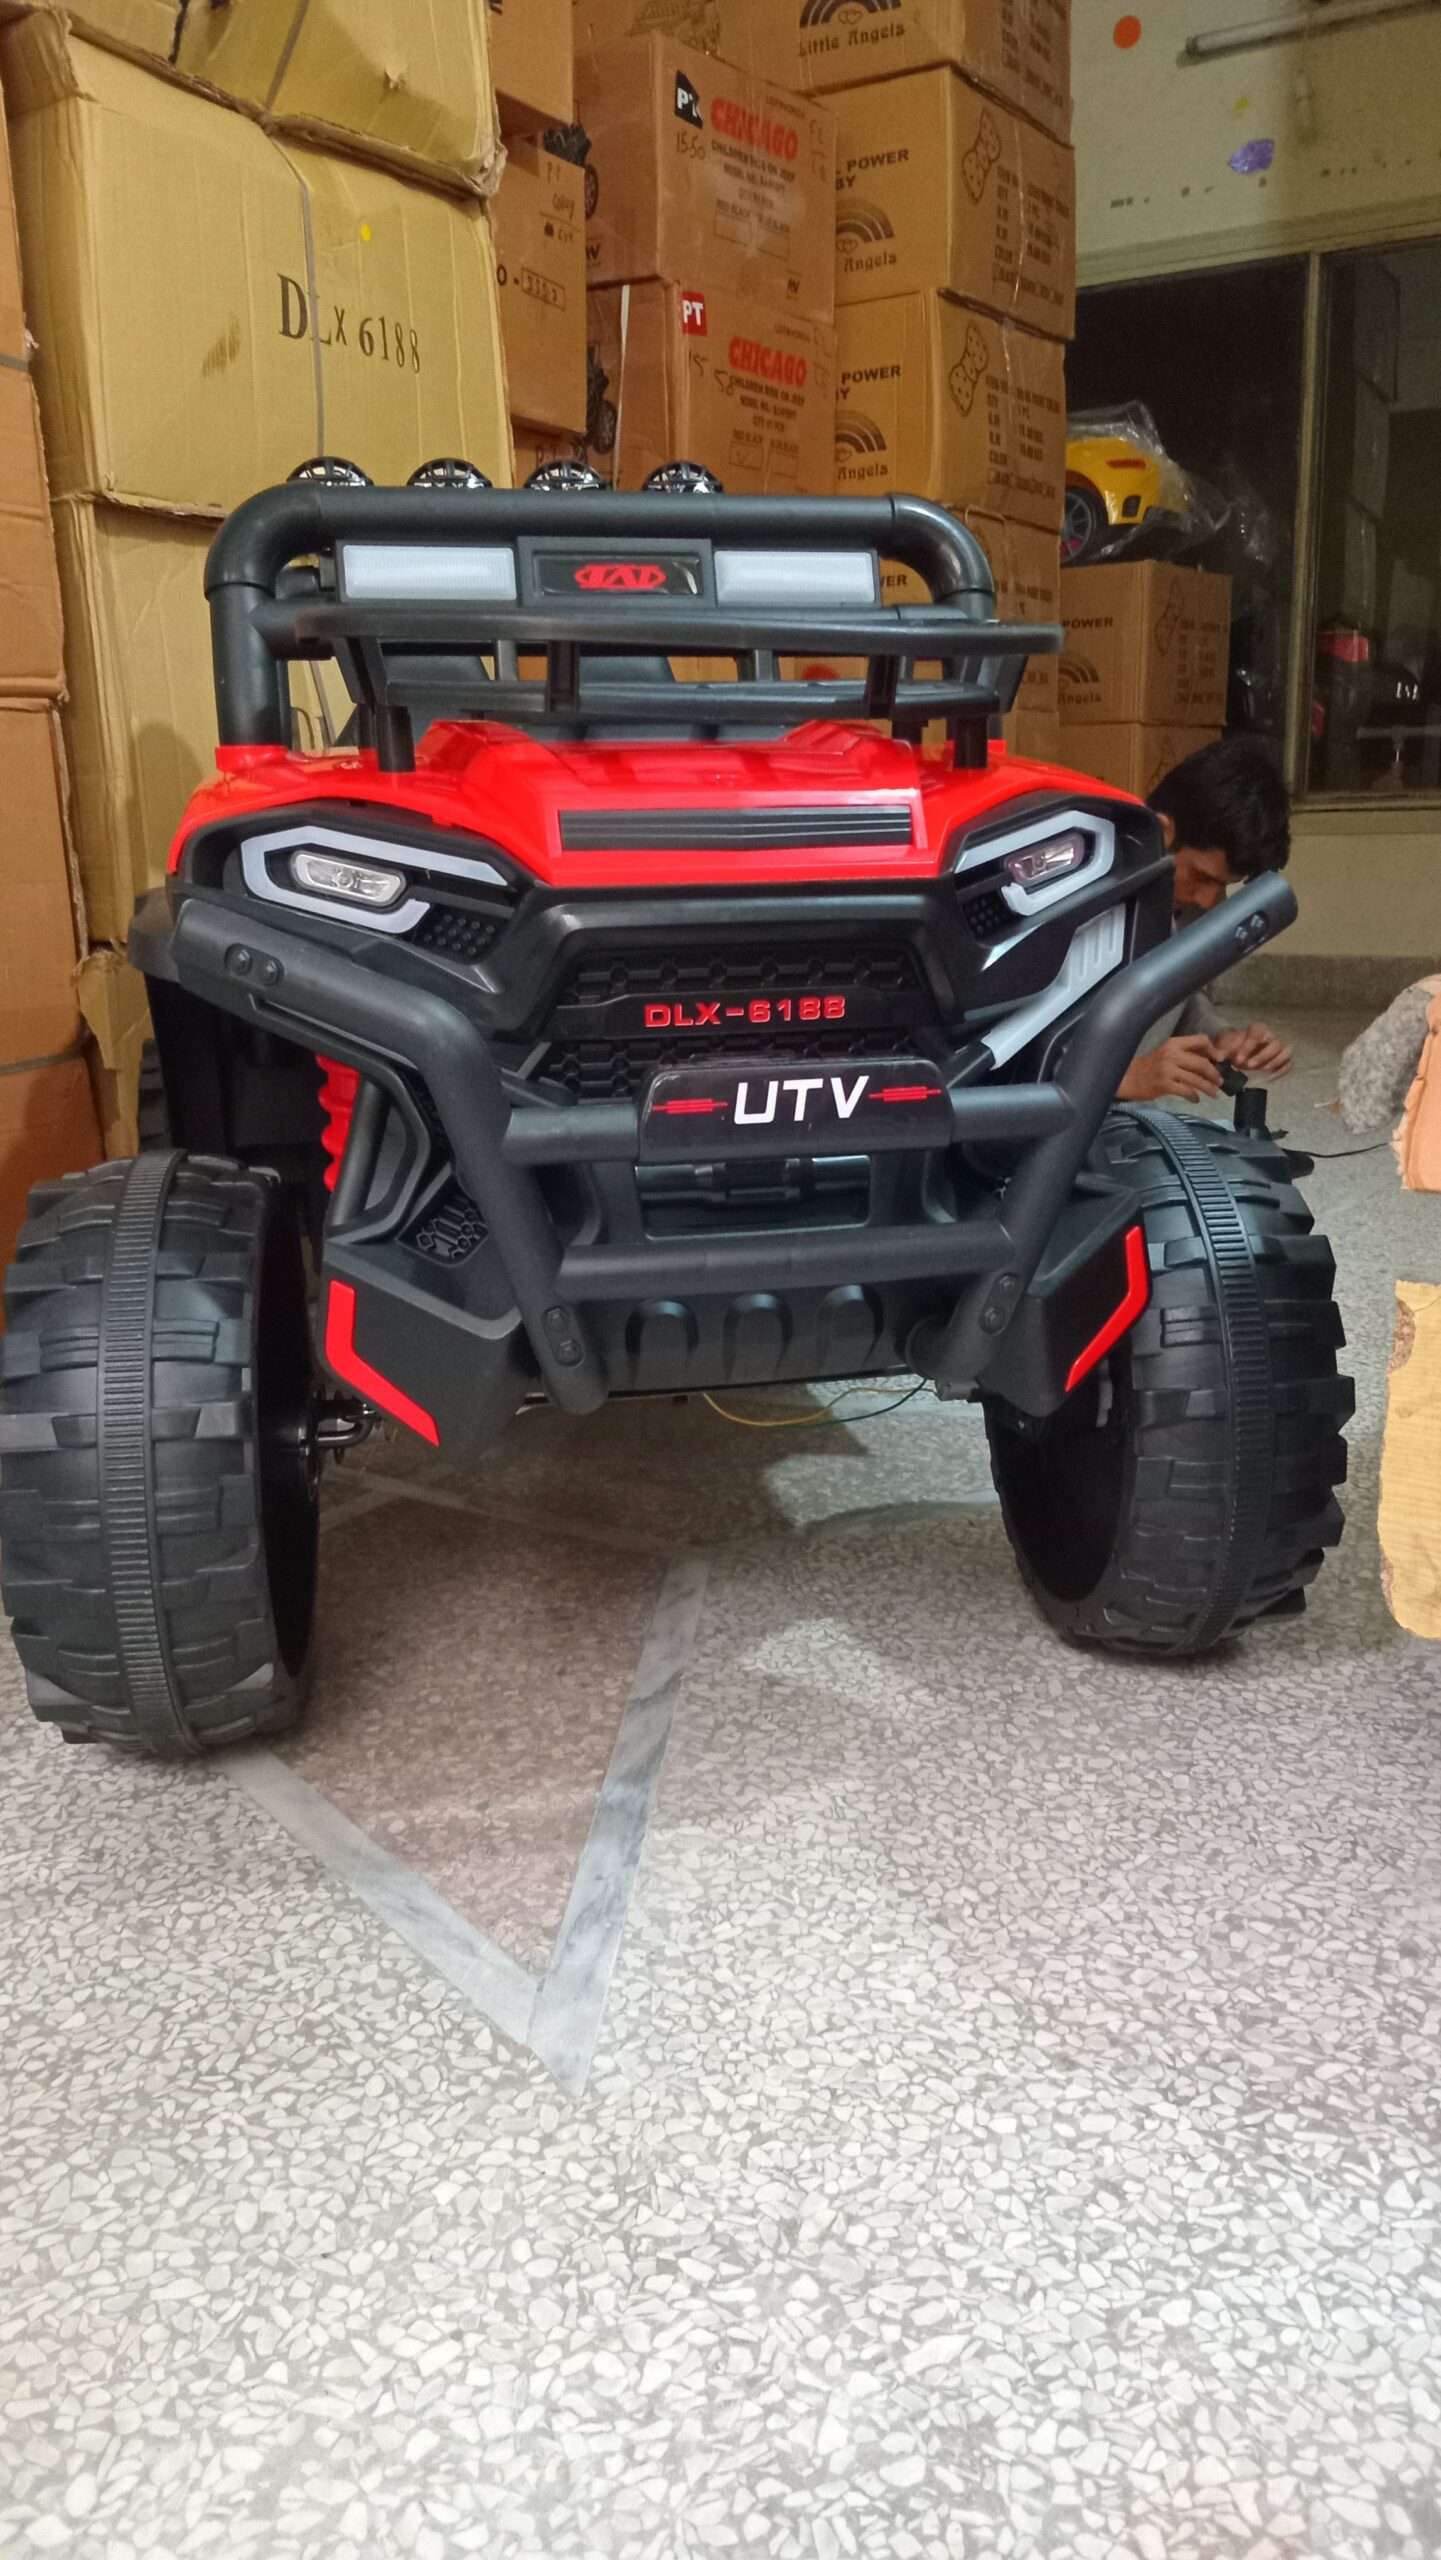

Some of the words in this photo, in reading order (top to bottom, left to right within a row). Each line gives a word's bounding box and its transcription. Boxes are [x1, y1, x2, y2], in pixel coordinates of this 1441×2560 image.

[798, 36, 839, 57] Little
[848, 22, 905, 46] Angels
[847, 149, 910, 172] POWER
[844, 251, 897, 272] Angels
[683, 300, 704, 326] PT
[359, 316, 420, 374] 6188
[728, 336, 807, 388] CHICAGO
[842, 365, 901, 385] POWER
[837, 463, 888, 480] Angels
[645, 996, 846, 1028] DLX-6188
[734, 1075, 870, 1126] UTV
